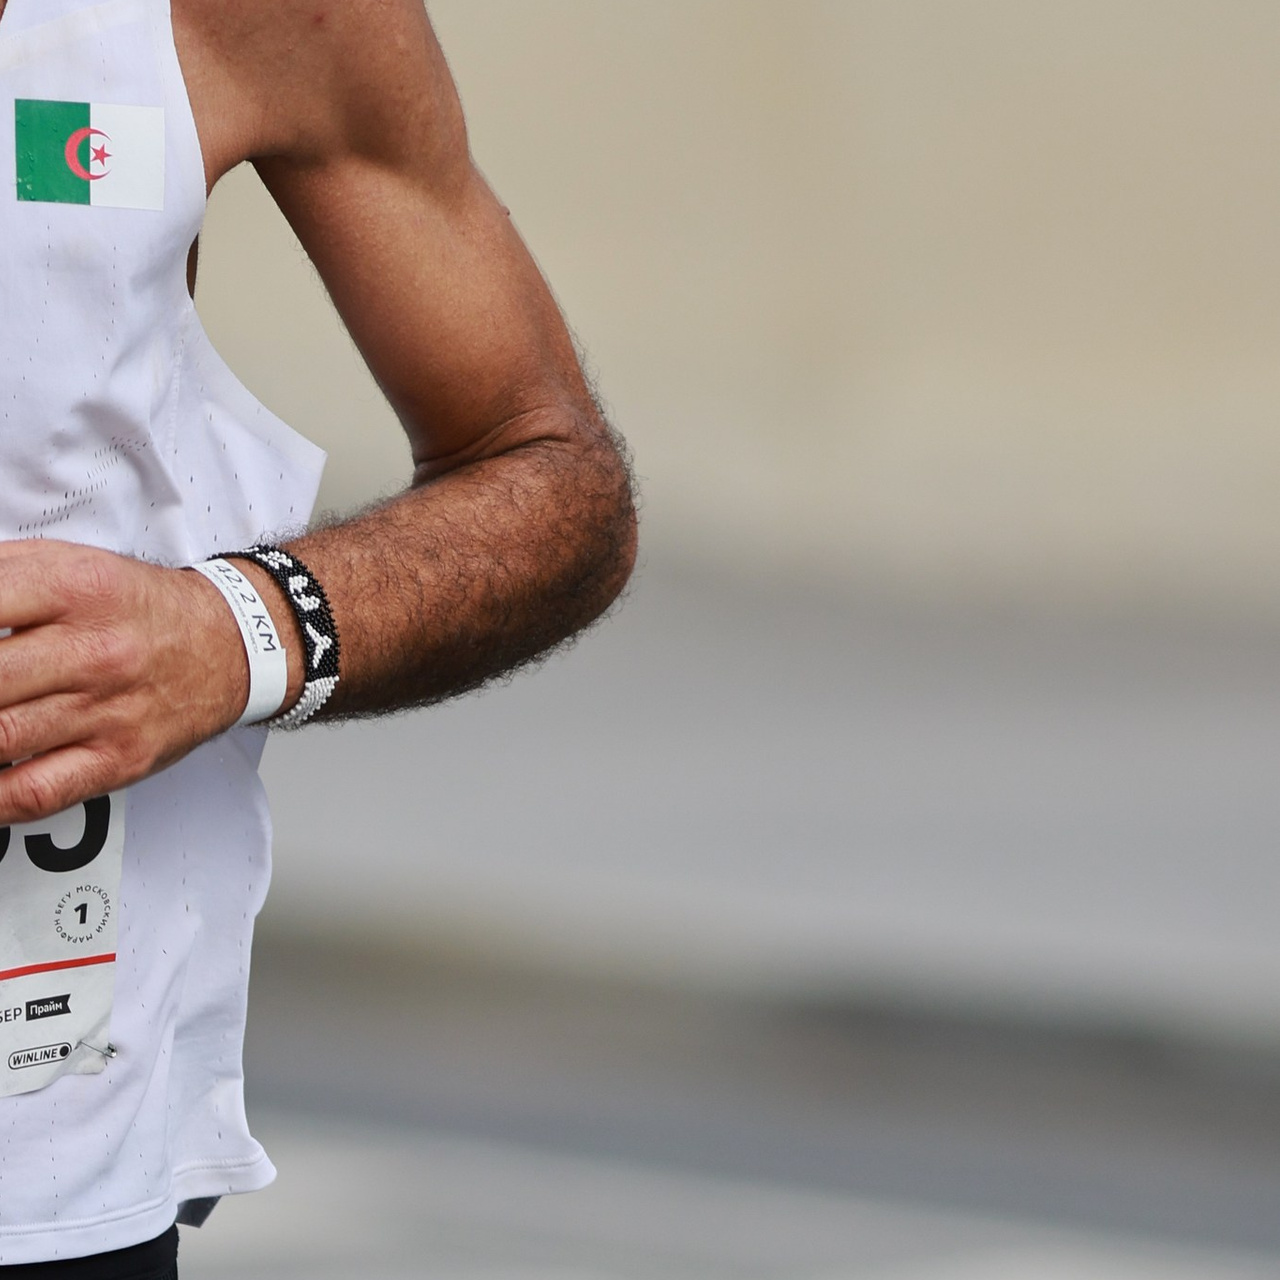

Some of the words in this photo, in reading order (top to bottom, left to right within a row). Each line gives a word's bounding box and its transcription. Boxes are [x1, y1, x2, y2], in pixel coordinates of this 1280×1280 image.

[73, 902, 88, 925] 1
[29, 1000, 63, 1016] Прайм
[12, 1048, 58, 1067] WINLINE
